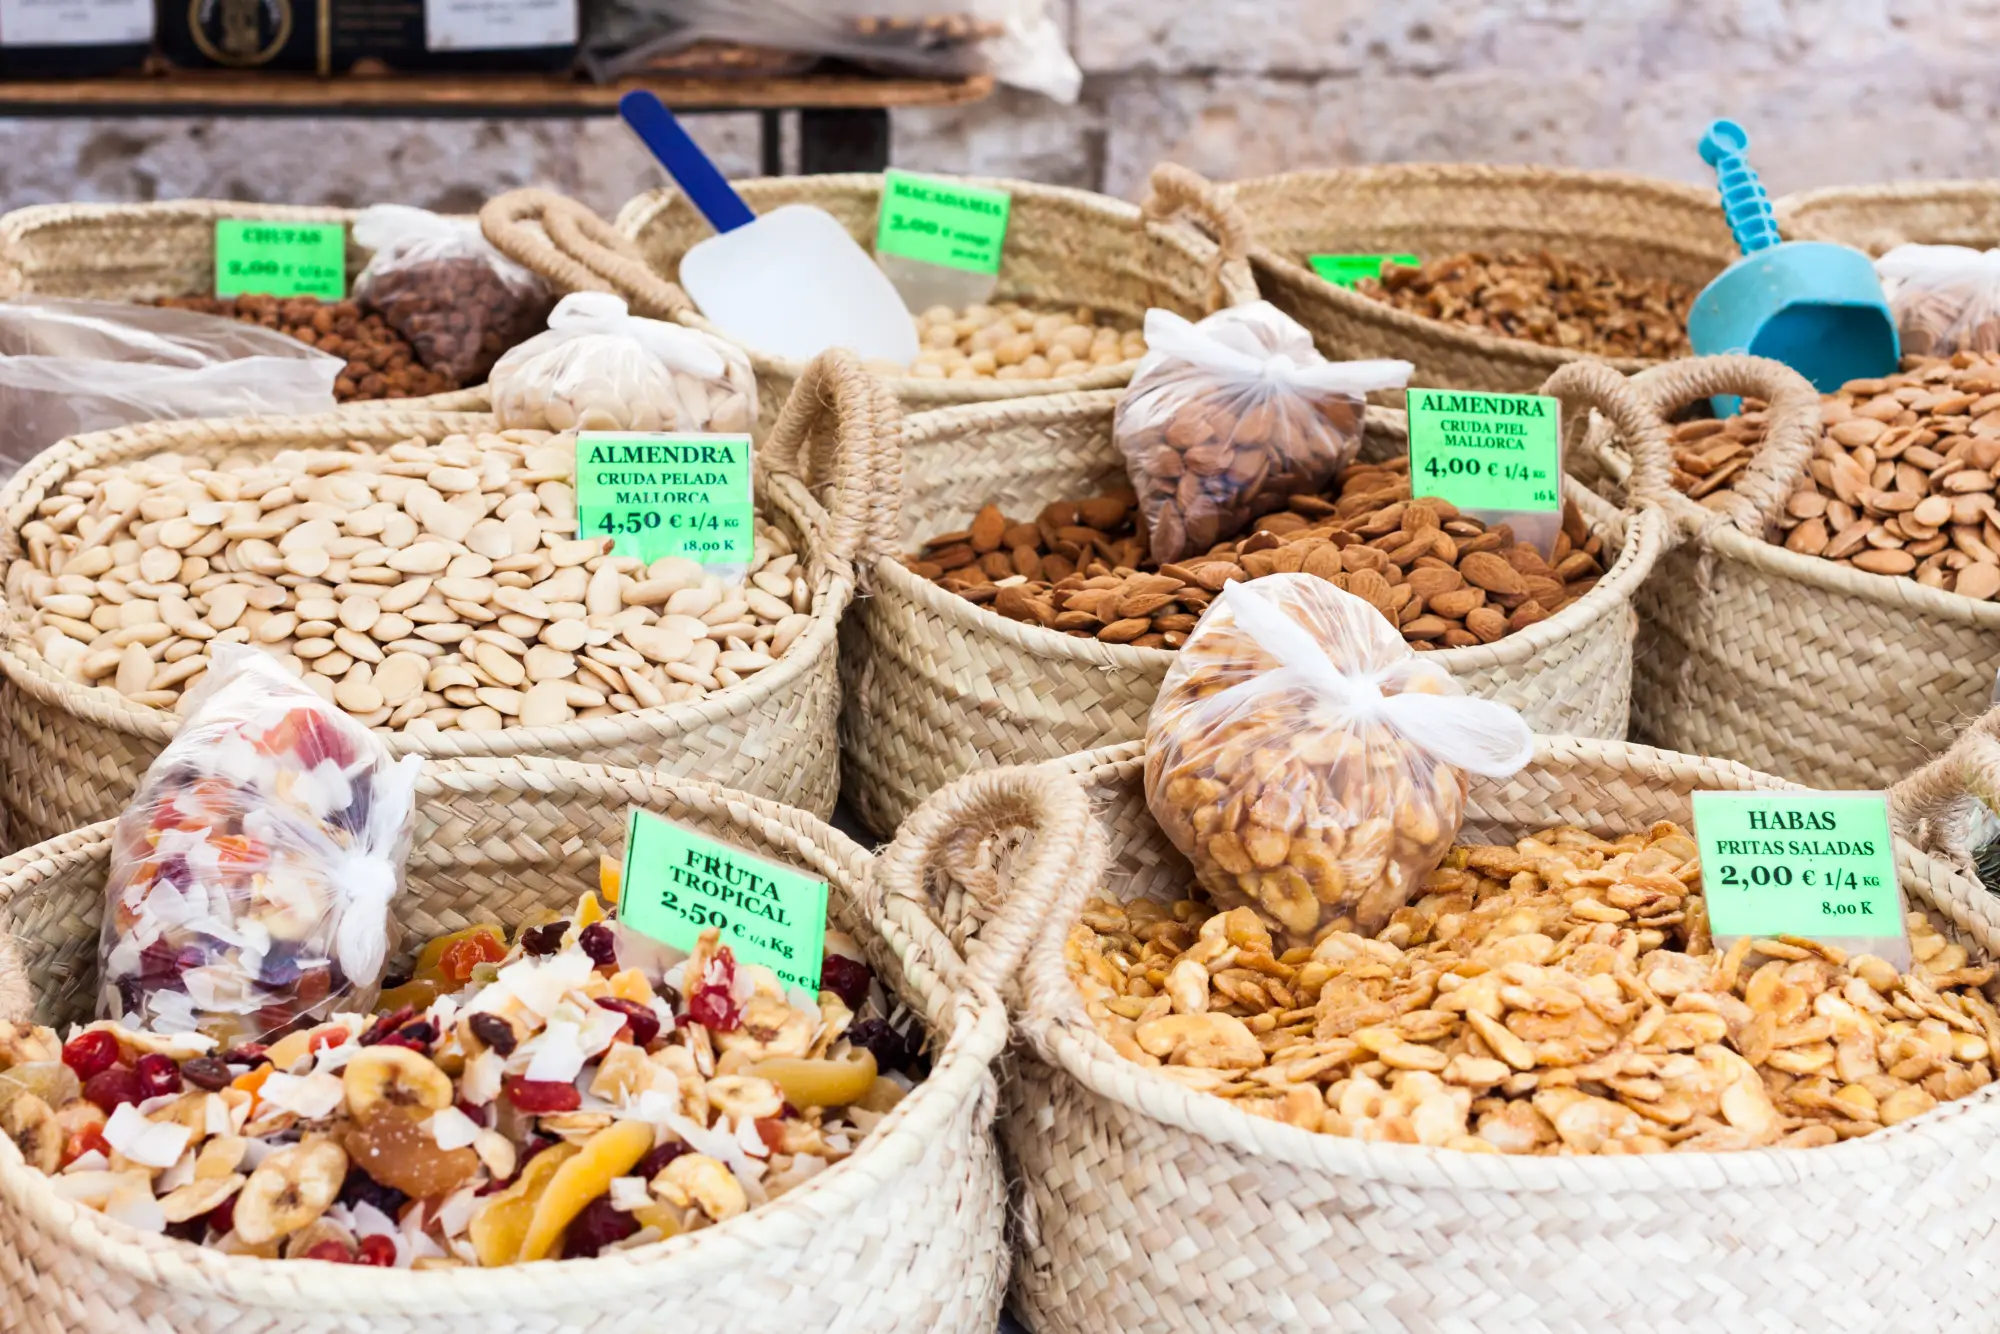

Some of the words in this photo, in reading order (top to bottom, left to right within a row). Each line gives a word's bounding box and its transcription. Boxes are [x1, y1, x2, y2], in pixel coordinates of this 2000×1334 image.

[1420, 394, 1545, 418] ALMENDRA
[1440, 419, 1492, 434] CRUDA
[1495, 422, 1528, 436] PIEL
[1444, 434, 1525, 450] MALLORCA
[588, 446, 736, 464] ALMENDRA
[1424, 456, 1481, 478] 4,00
[1487, 462, 1498, 477] €
[1504, 462, 1529, 481] 1/4
[597, 473, 657, 486] CRUDA
[661, 473, 729, 486] PELADA
[616, 491, 710, 504] MALLORCA
[1534, 491, 1547, 502] 16
[598, 511, 661, 534] 4,50
[669, 514, 682, 529] €
[689, 512, 719, 531] 1/4
[724, 518, 739, 527] KG
[684, 539, 720, 552] 18,00
[724, 539, 734, 550] K
[1747, 810, 1836, 831] HABAS
[1716, 840, 1785, 856] FRITAS
[1788, 840, 1875, 856] SALADAS
[684, 847, 781, 902] FRUTA
[1720, 865, 1793, 892] 2,00
[1802, 869, 1816, 886] €
[1824, 867, 1858, 890] 1/4
[1863, 876, 1881, 886] KG
[669, 865, 791, 927] TROPICAL
[1822, 901, 1857, 917] 8,00
[1860, 901, 1874, 915] K
[660, 890, 728, 930] 2,50
[733, 923, 746, 939] €
[749, 935, 766, 948] 1/4
[770, 936, 794, 959] Kg
